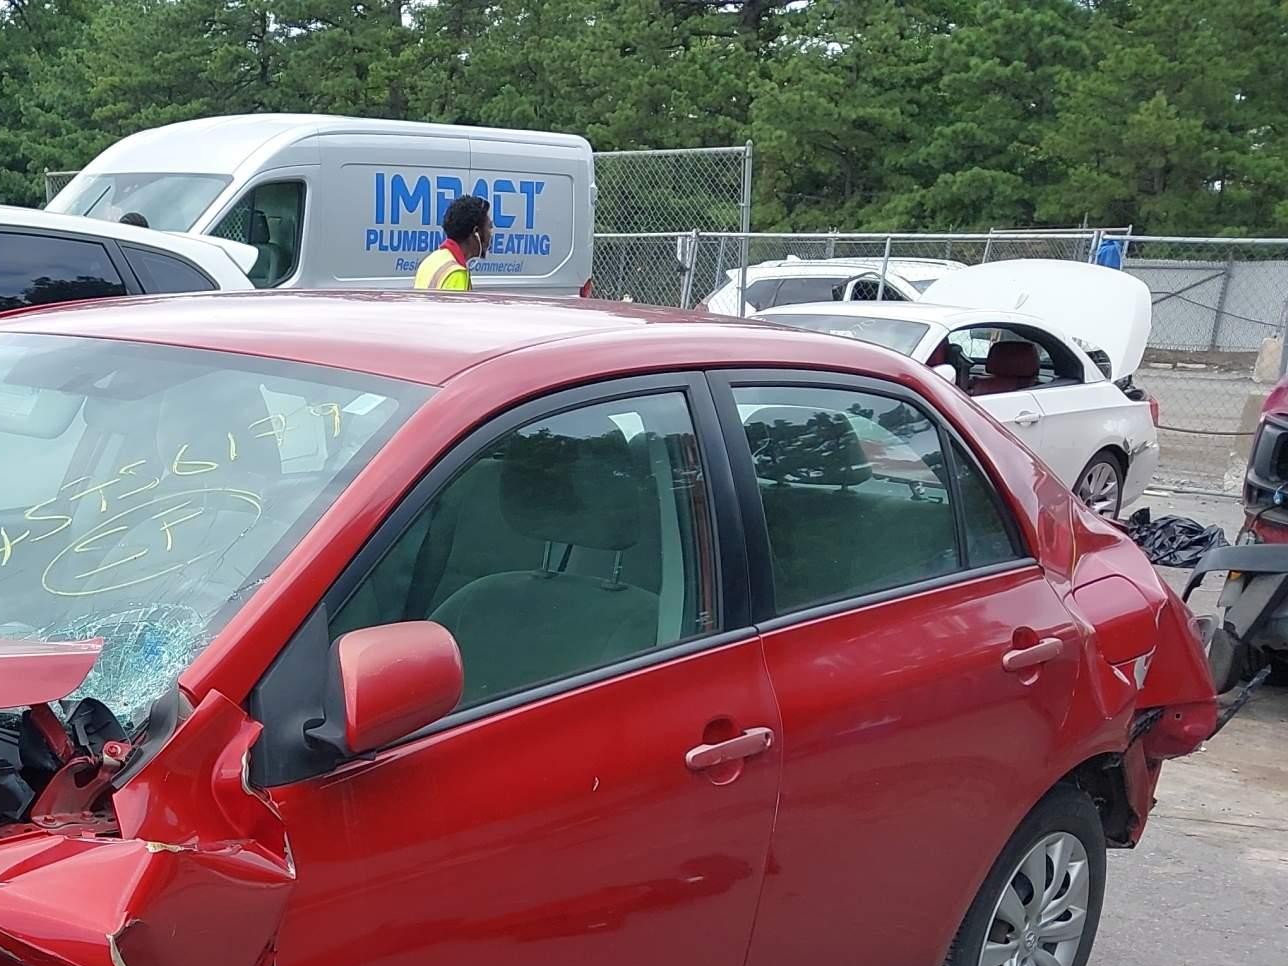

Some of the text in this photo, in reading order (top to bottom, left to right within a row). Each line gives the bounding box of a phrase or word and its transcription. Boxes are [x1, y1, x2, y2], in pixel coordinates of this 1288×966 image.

[366, 229, 551, 256] PLUMBIN EATING
[468, 259, 525, 273] Commercial
